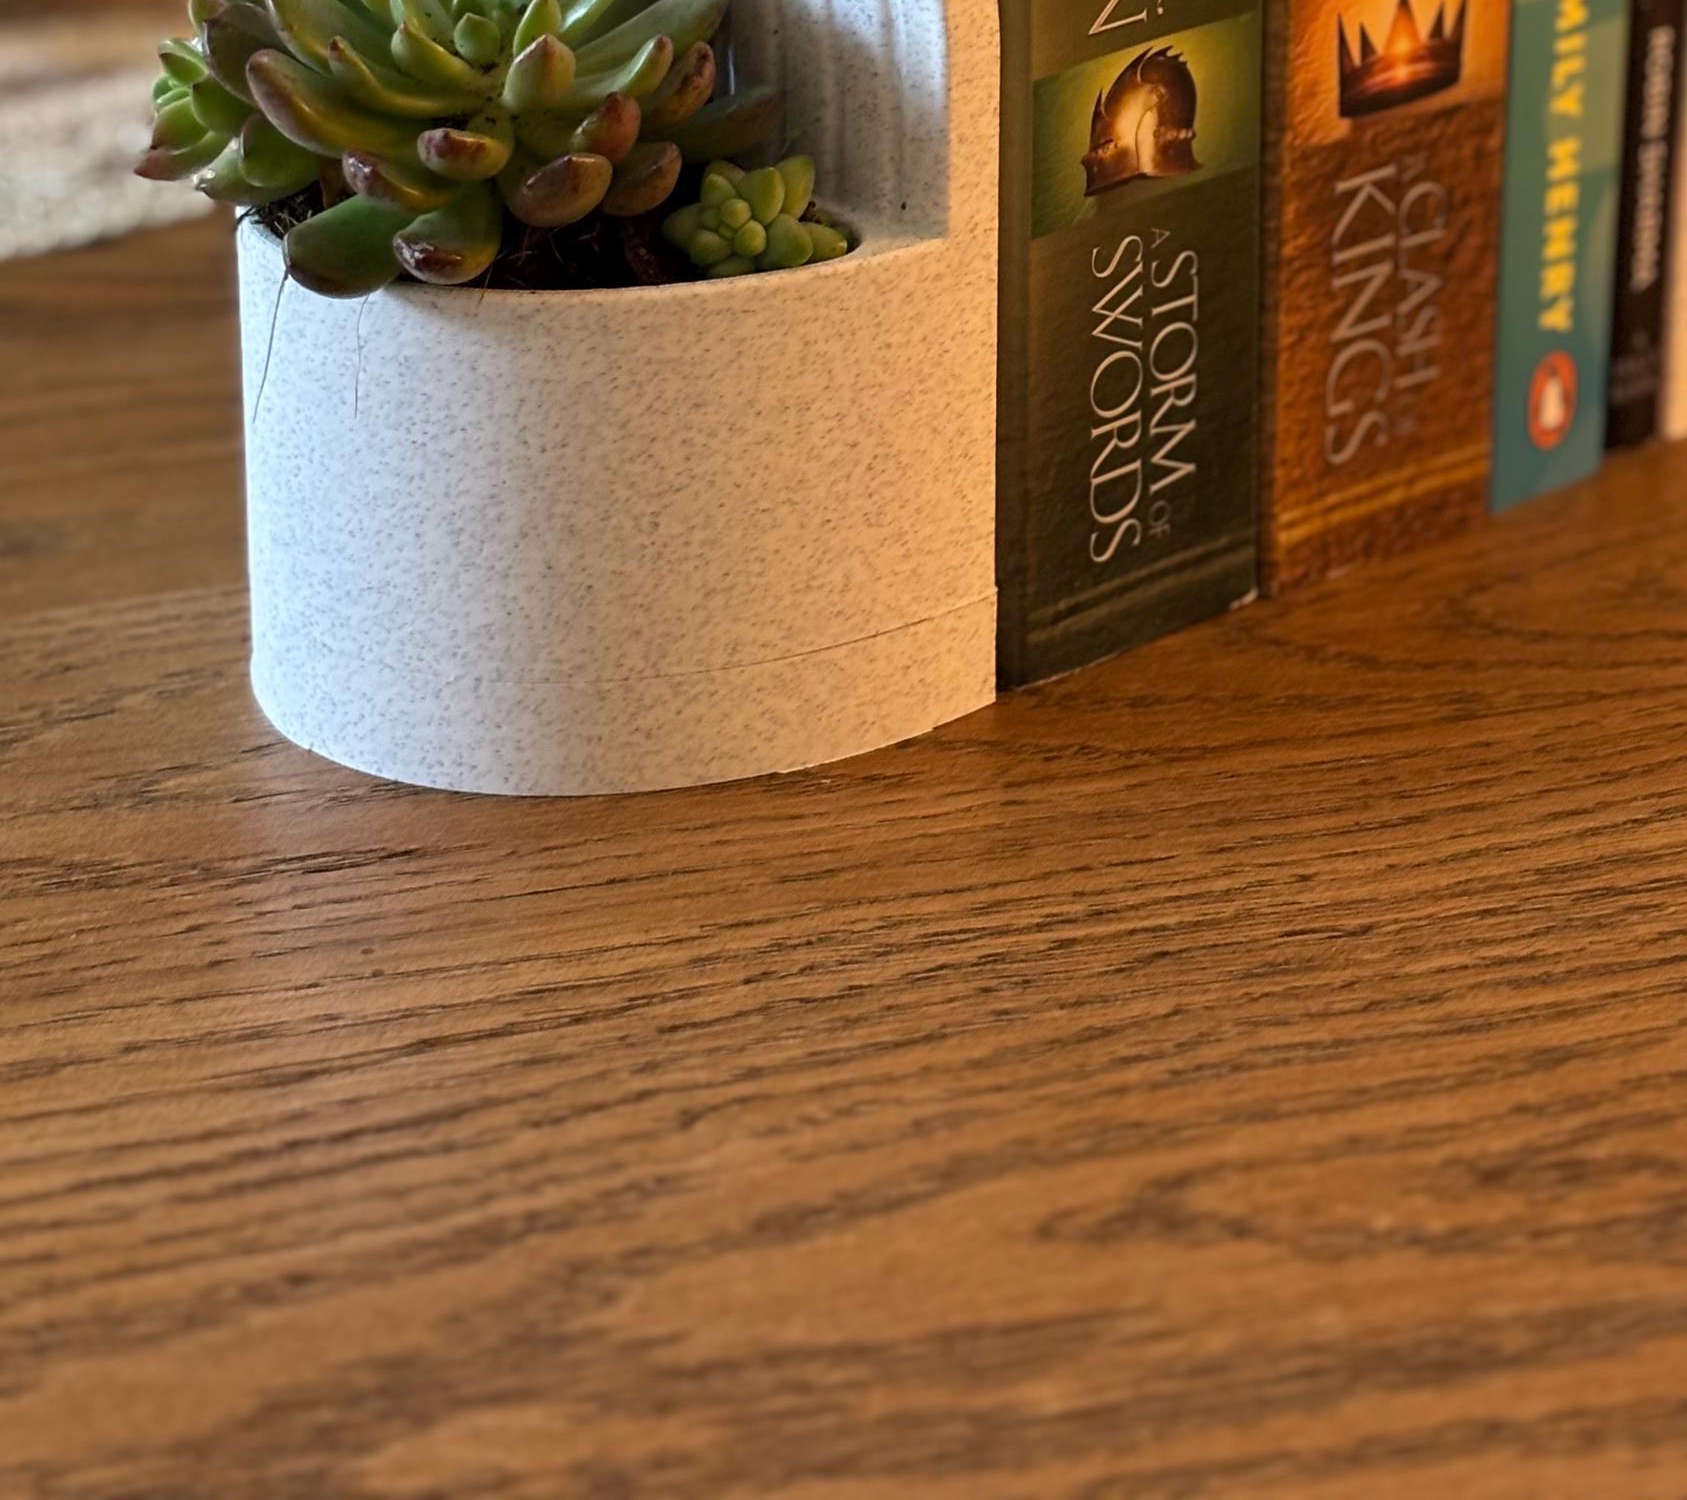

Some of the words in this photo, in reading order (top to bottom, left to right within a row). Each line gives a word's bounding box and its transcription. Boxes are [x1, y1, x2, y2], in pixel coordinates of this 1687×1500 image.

[1150, 226, 1172, 250] A
[1326, 164, 1398, 465] KINGS
[1394, 181, 1449, 390] CLASH
[1538, 137, 1583, 332] HENRY
[1089, 235, 1145, 564] SWORDS
[1149, 249, 1200, 494] STORM
[1147, 500, 1173, 541] OF
